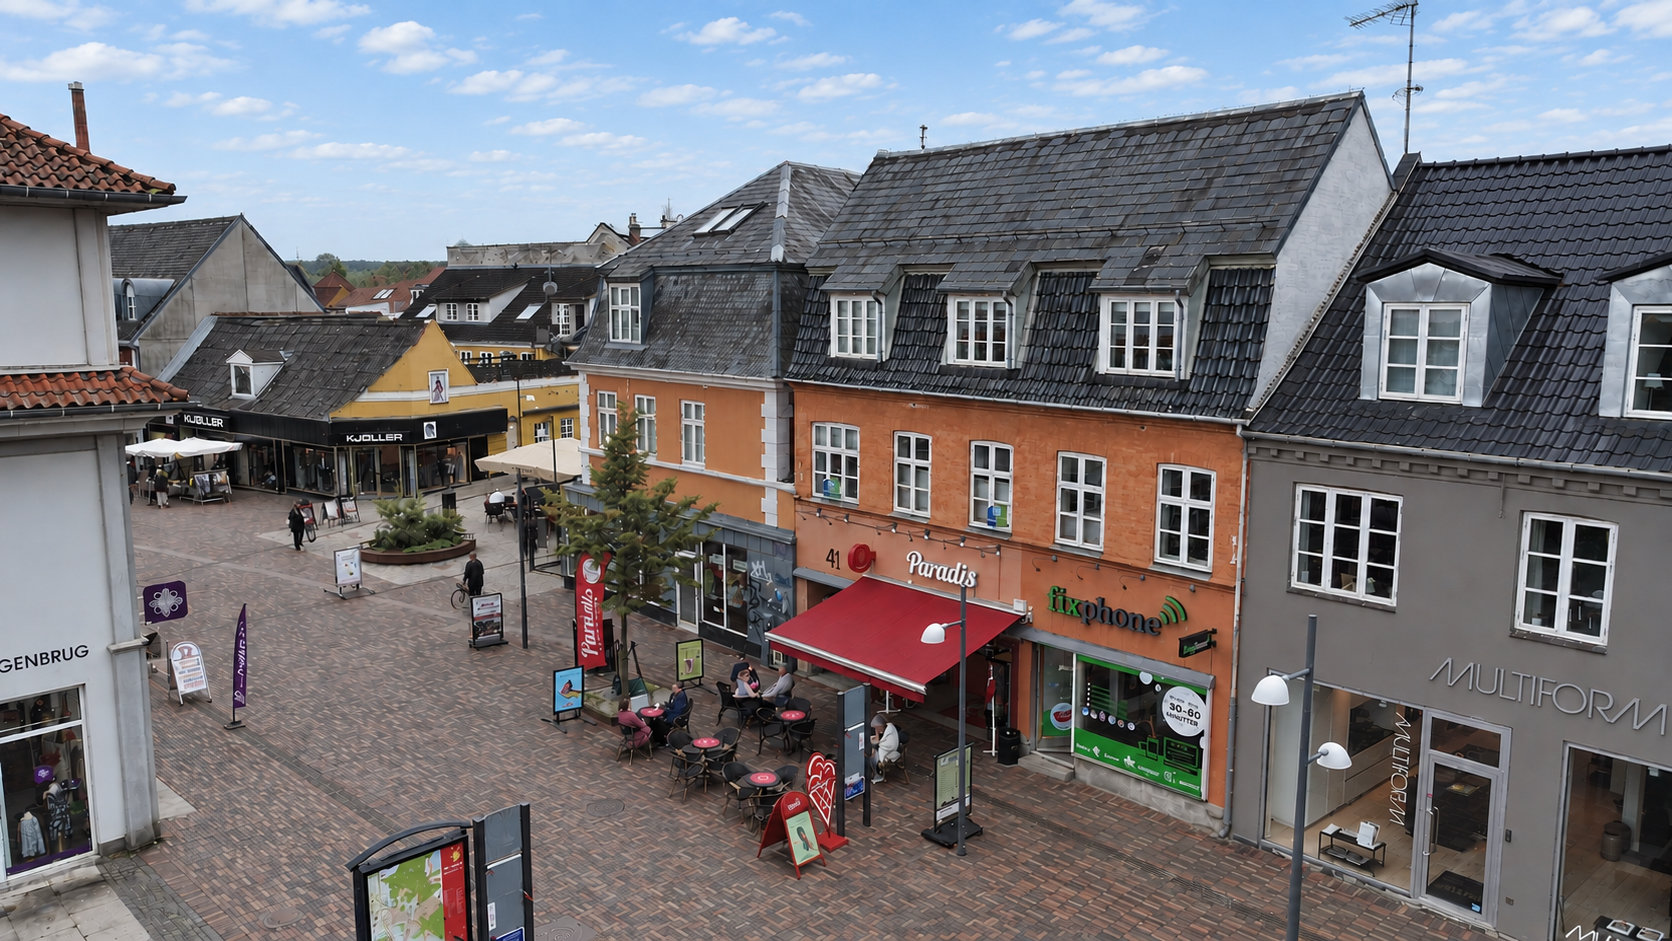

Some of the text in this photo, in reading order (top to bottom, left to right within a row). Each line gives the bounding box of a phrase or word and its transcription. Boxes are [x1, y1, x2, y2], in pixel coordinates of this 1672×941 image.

[826, 548, 841, 570] 41
[906, 550, 977, 588] Paradis
[1047, 585, 1163, 636] fixphone
[0, 644, 89, 673] GENBRUG
[1169, 702, 1201, 720] 30-60
[1429, 657, 1668, 735] MULTIFORM
[1389, 712, 1411, 826] MULTIFORM
